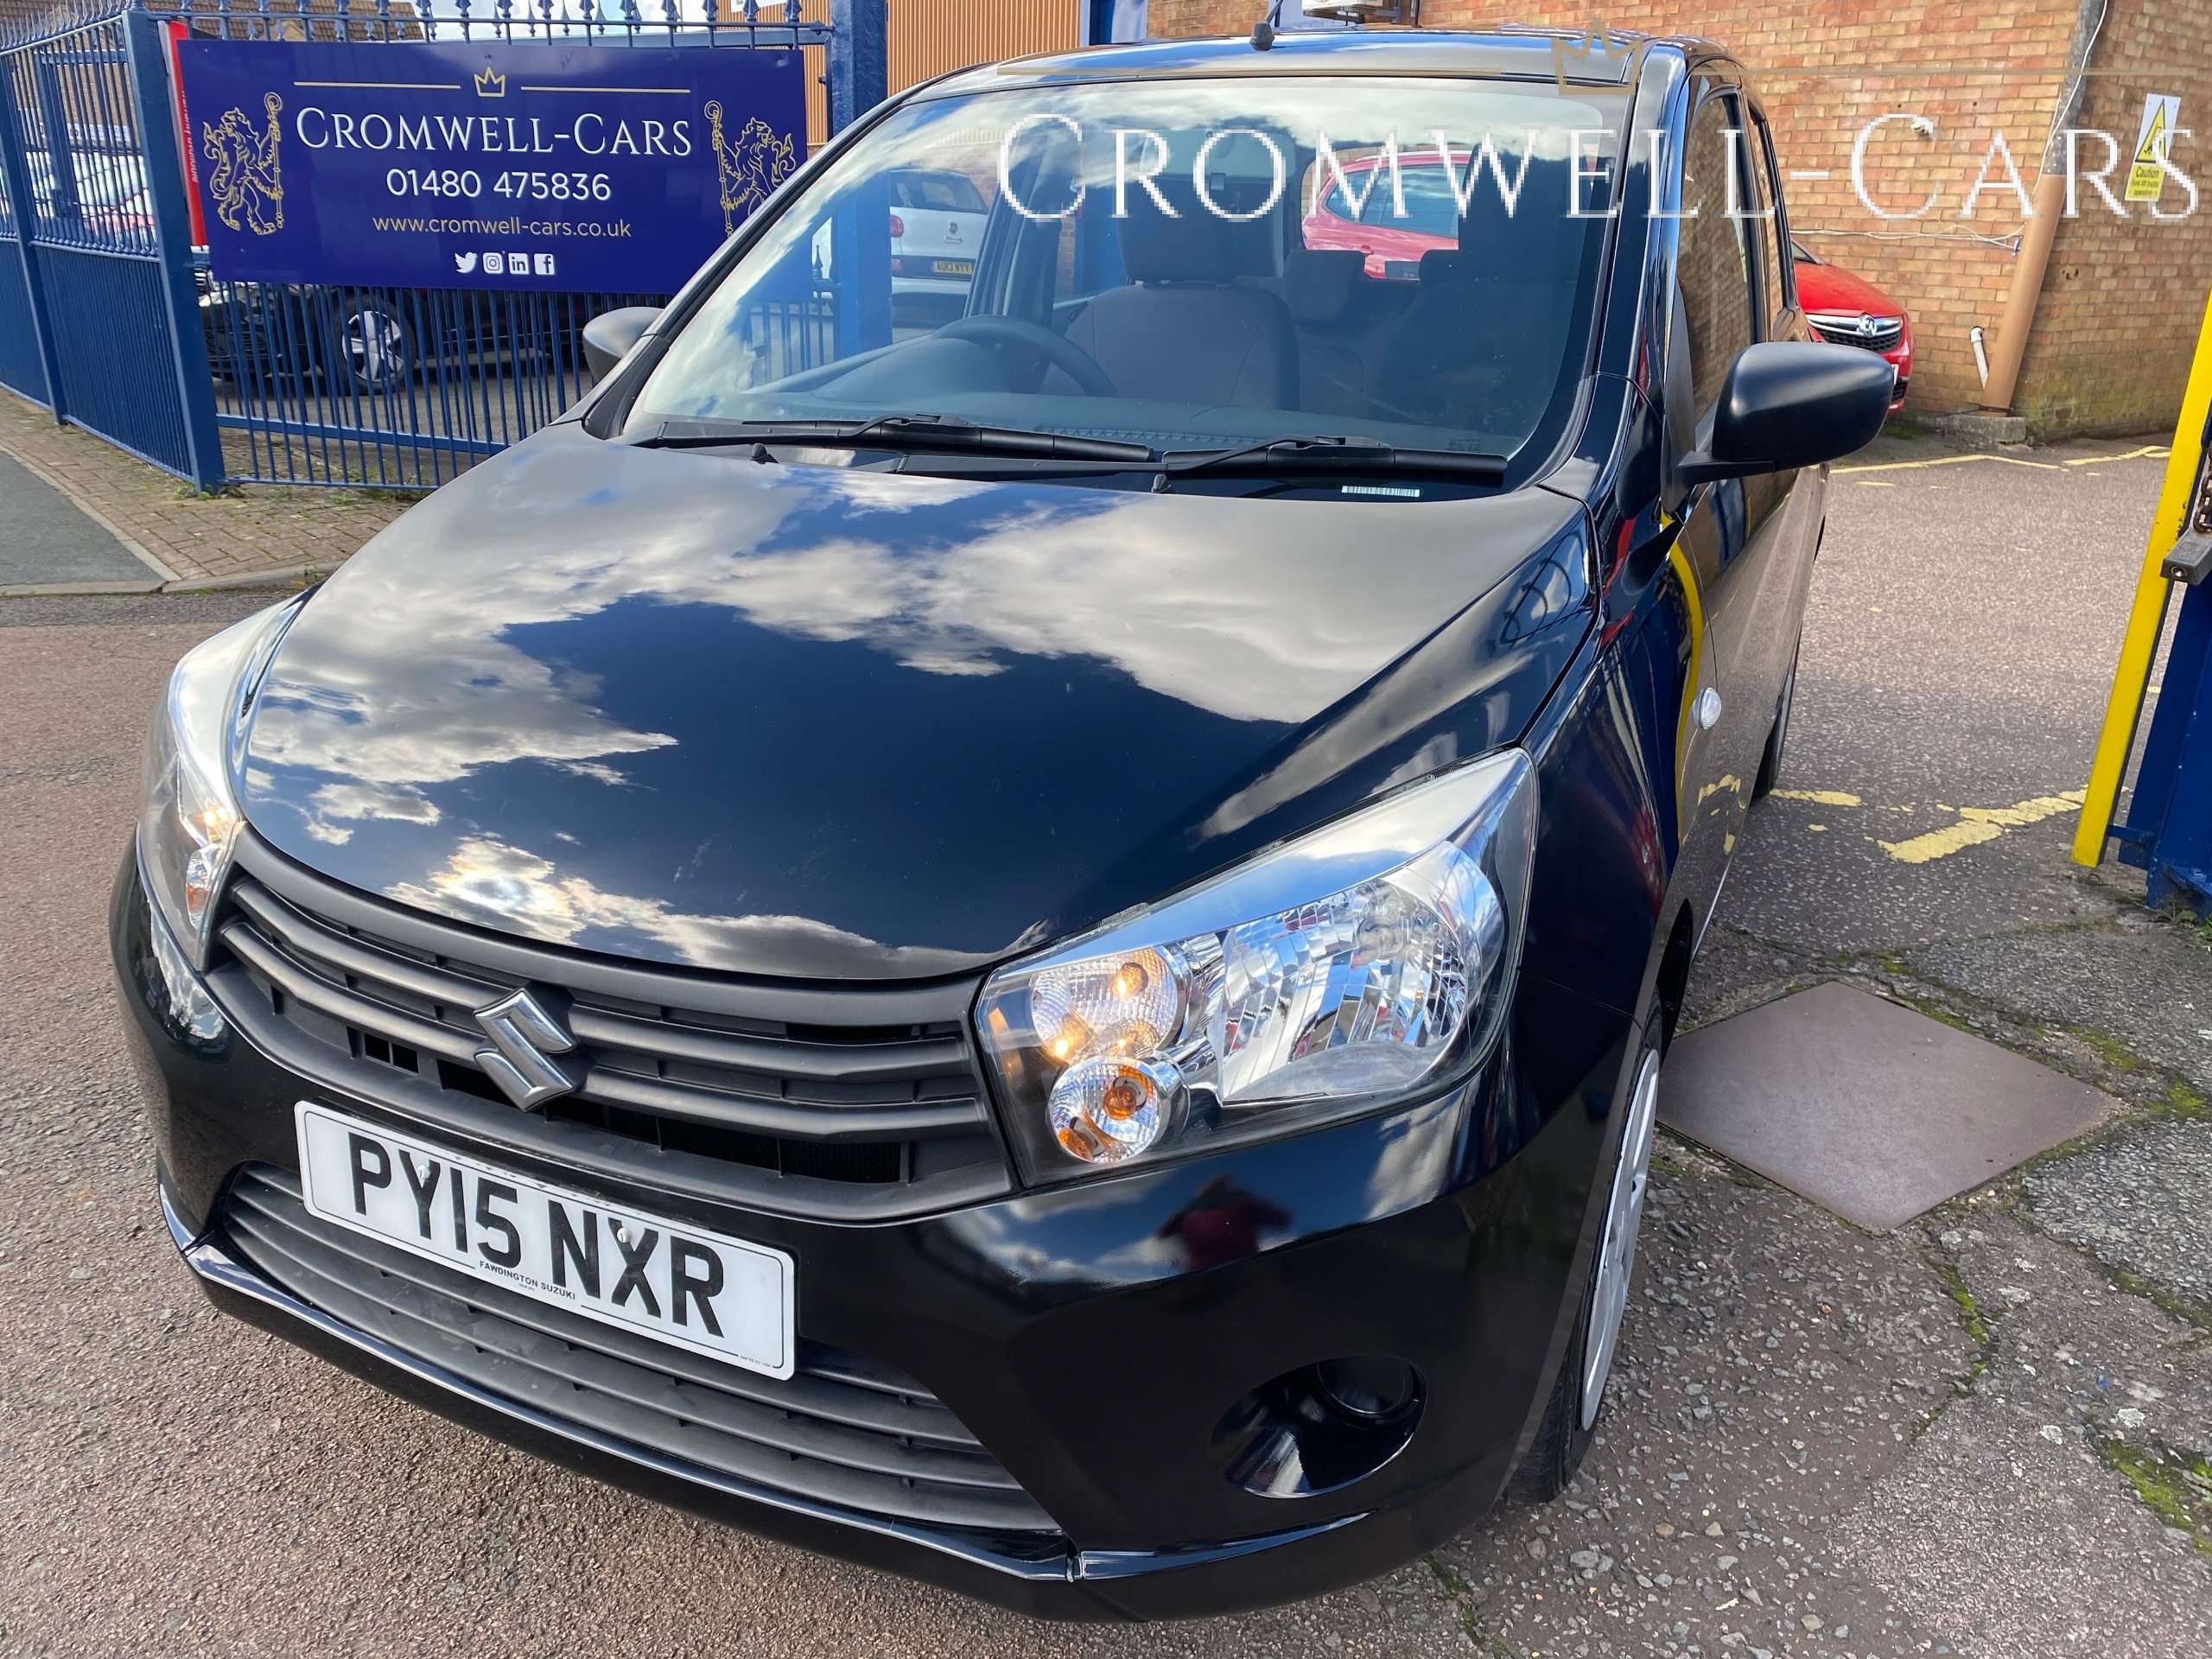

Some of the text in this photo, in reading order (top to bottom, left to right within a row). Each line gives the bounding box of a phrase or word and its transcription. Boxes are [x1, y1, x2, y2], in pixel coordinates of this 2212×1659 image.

[385, 168, 612, 201] 01480 475836
[2136, 166, 2159, 178] Caution
[372, 215, 632, 238] www.cromwell-cars.co.uk
[347, 1132, 725, 1338] PY15 NXR
[479, 1260, 539, 1287] FAWDINGTON
[540, 1282, 575, 1300] SUZUKI
